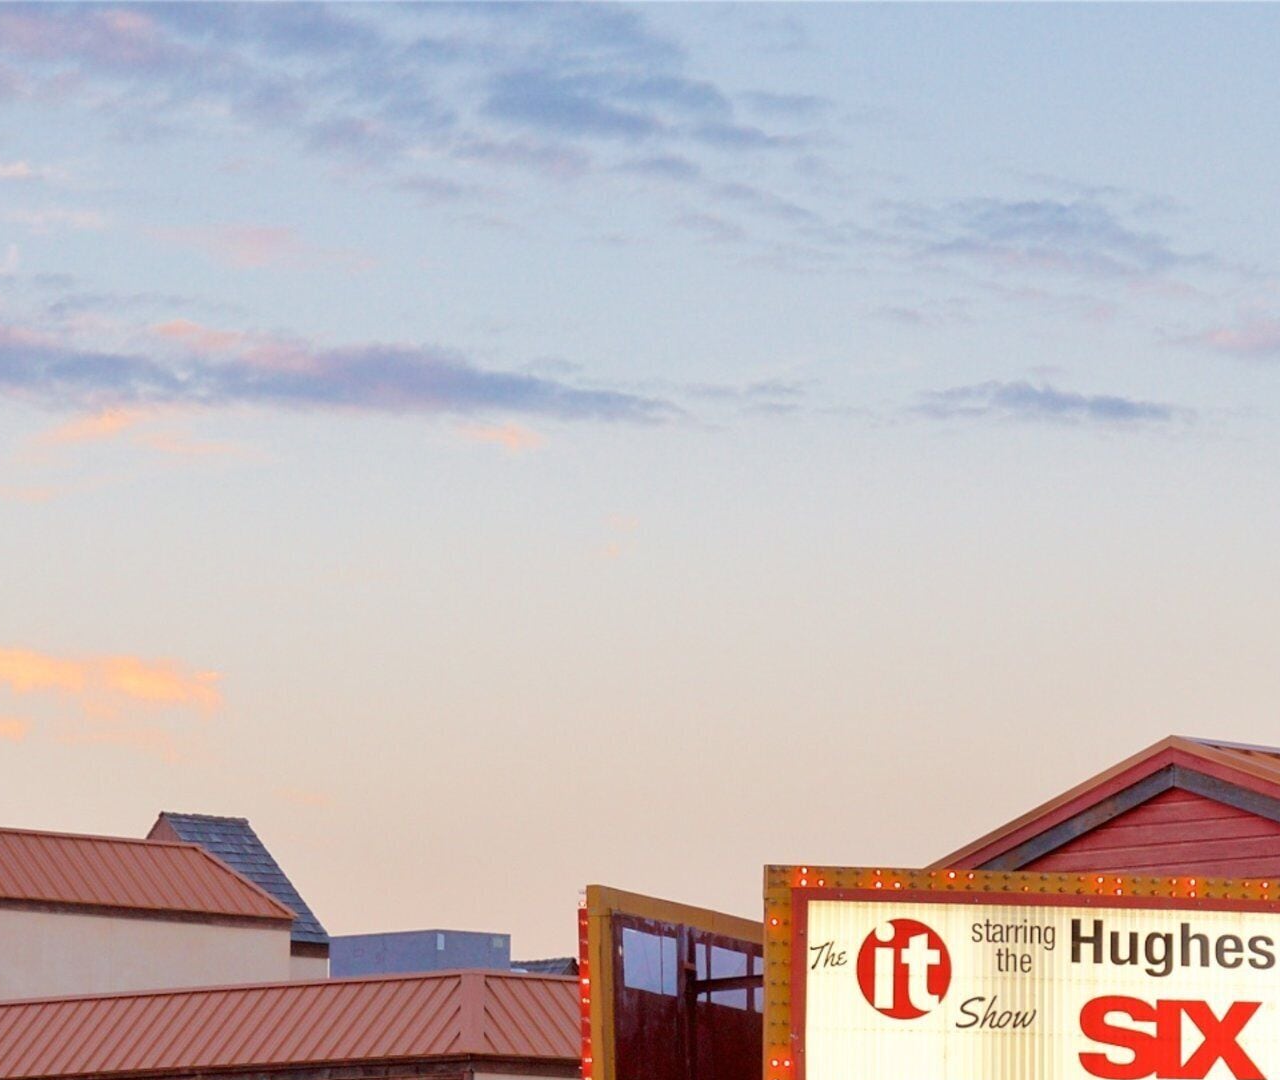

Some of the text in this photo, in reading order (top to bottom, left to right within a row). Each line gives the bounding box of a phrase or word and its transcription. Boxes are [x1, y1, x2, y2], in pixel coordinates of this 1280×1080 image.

[971, 919, 1057, 950] starring
[810, 920, 1037, 1029] The it Show
[996, 948, 1032, 974] the
